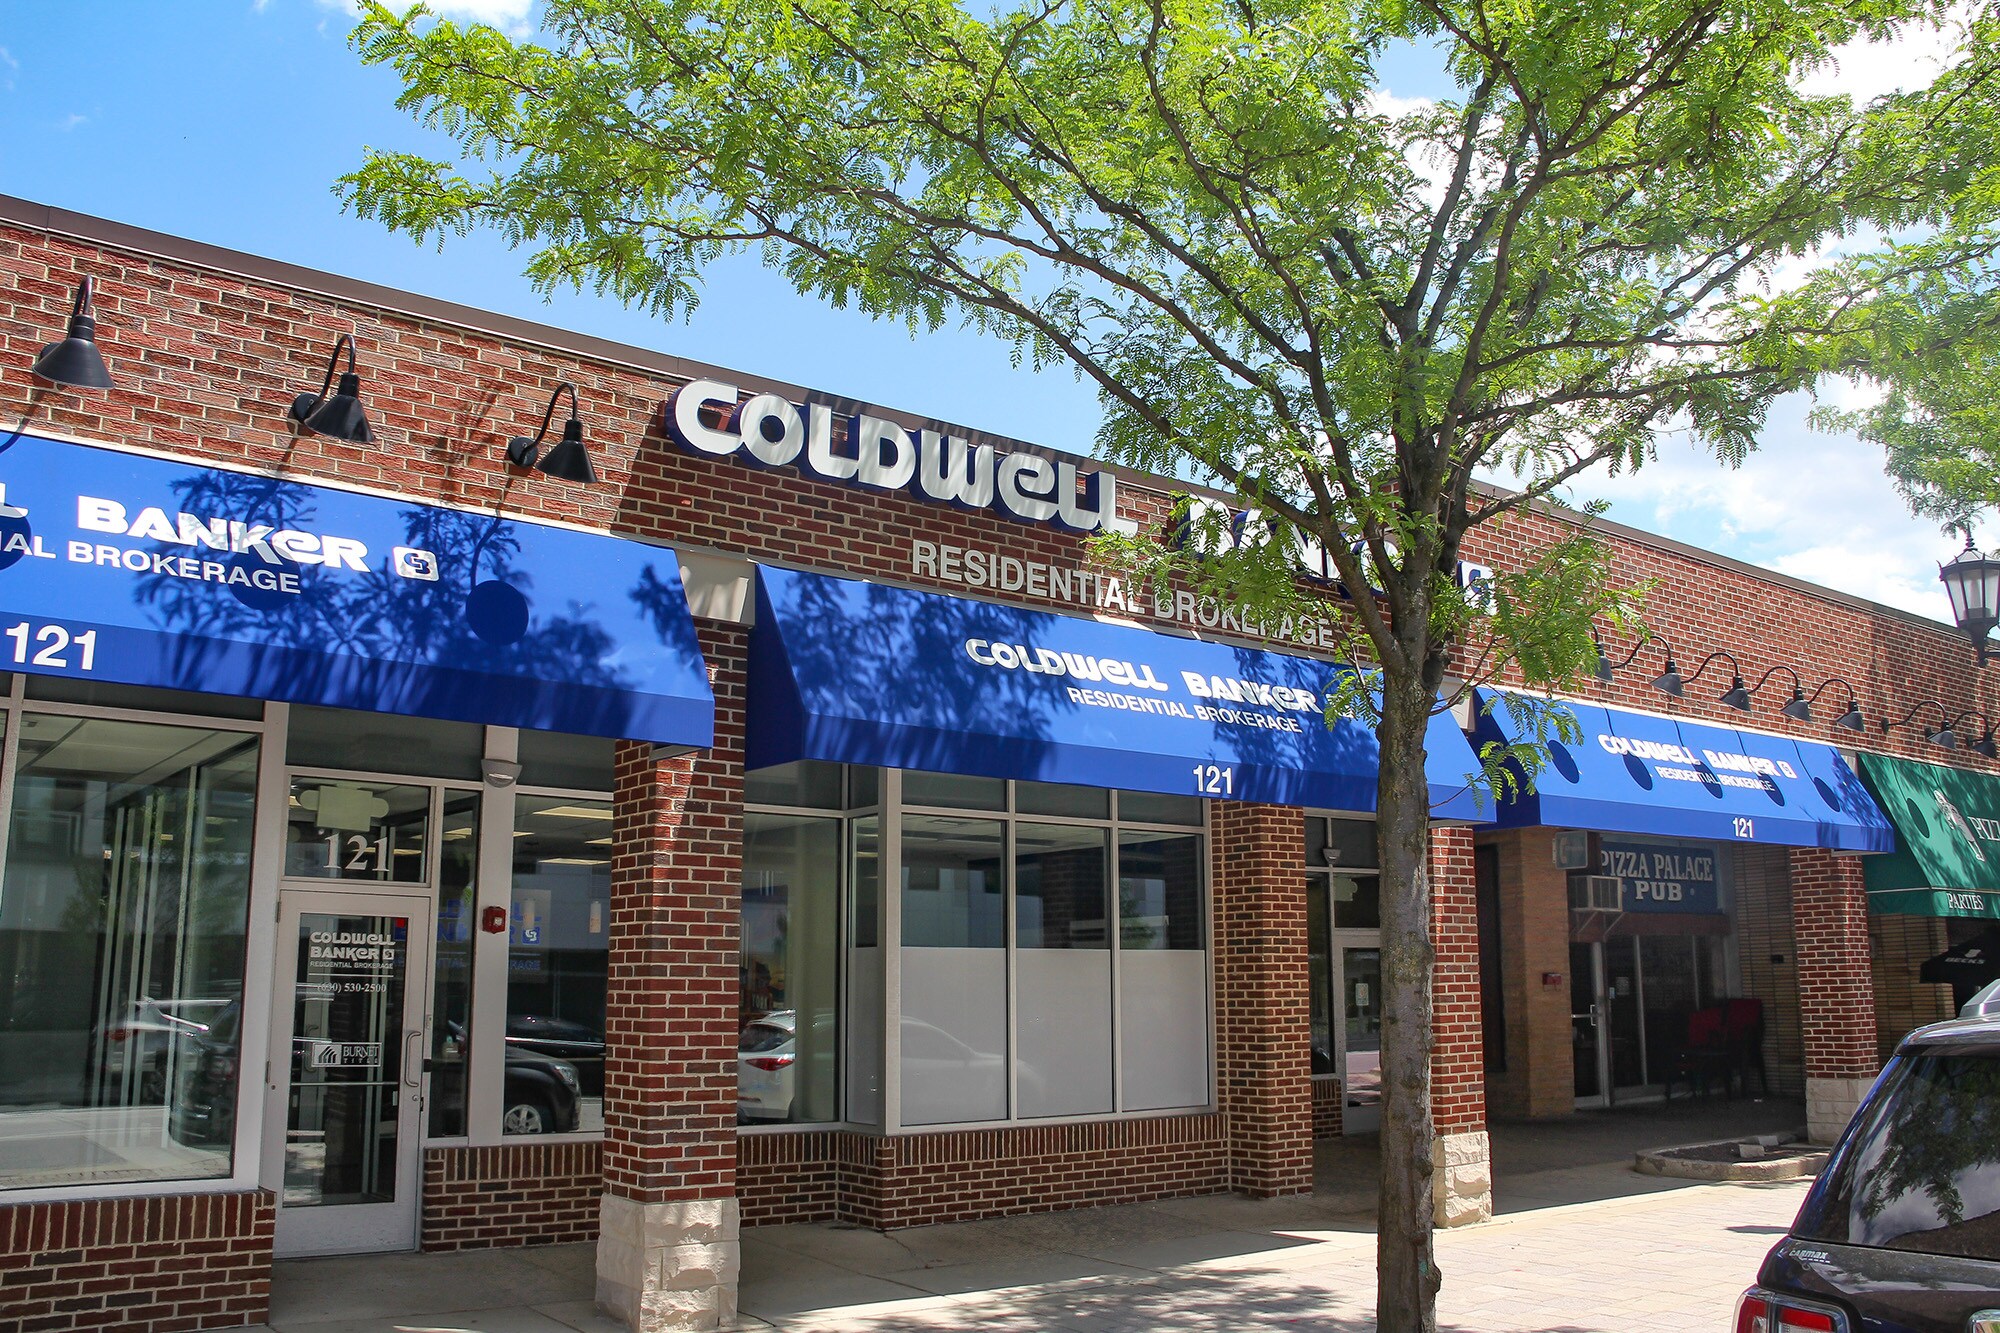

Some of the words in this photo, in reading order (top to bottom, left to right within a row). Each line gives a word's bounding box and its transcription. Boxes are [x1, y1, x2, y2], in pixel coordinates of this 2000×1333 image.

[672, 377, 1139, 538] COLDWELL
[78, 495, 371, 573] BANKER
[68, 540, 302, 594] BROKERAGE
[912, 539, 1146, 614] RESIDENTIAL
[6, 622, 97, 671] 121
[964, 637, 1168, 692] COLDWELL
[1180, 670, 1323, 715] BANKER
[1066, 686, 1194, 719] RESIDENTIAL
[1193, 704, 1303, 734] BROKERAGE
[1597, 733, 1700, 766] COLDWELL
[1701, 749, 1781, 778] BANKER
[1193, 764, 1233, 794] 121
[1654, 766, 1721, 785] RESIDENTIAL
[1719, 774, 1776, 792] BROKERAGE
[1733, 817, 1755, 839] 121
[323, 832, 390, 872] 121
[1601, 850, 1650, 879] PIZZA
[1653, 854, 1713, 881] PALACE
[1634, 881, 1683, 901] PUB
[1946, 892, 1984, 910] PARTIES
[310, 931, 396, 945] COLDWELL
[309, 961, 352, 969] RESIDENTIAL
[310, 946, 380, 961] BANKER
[344, 983, 388, 993] 530-2500
[343, 1046, 380, 1058] BURNET
